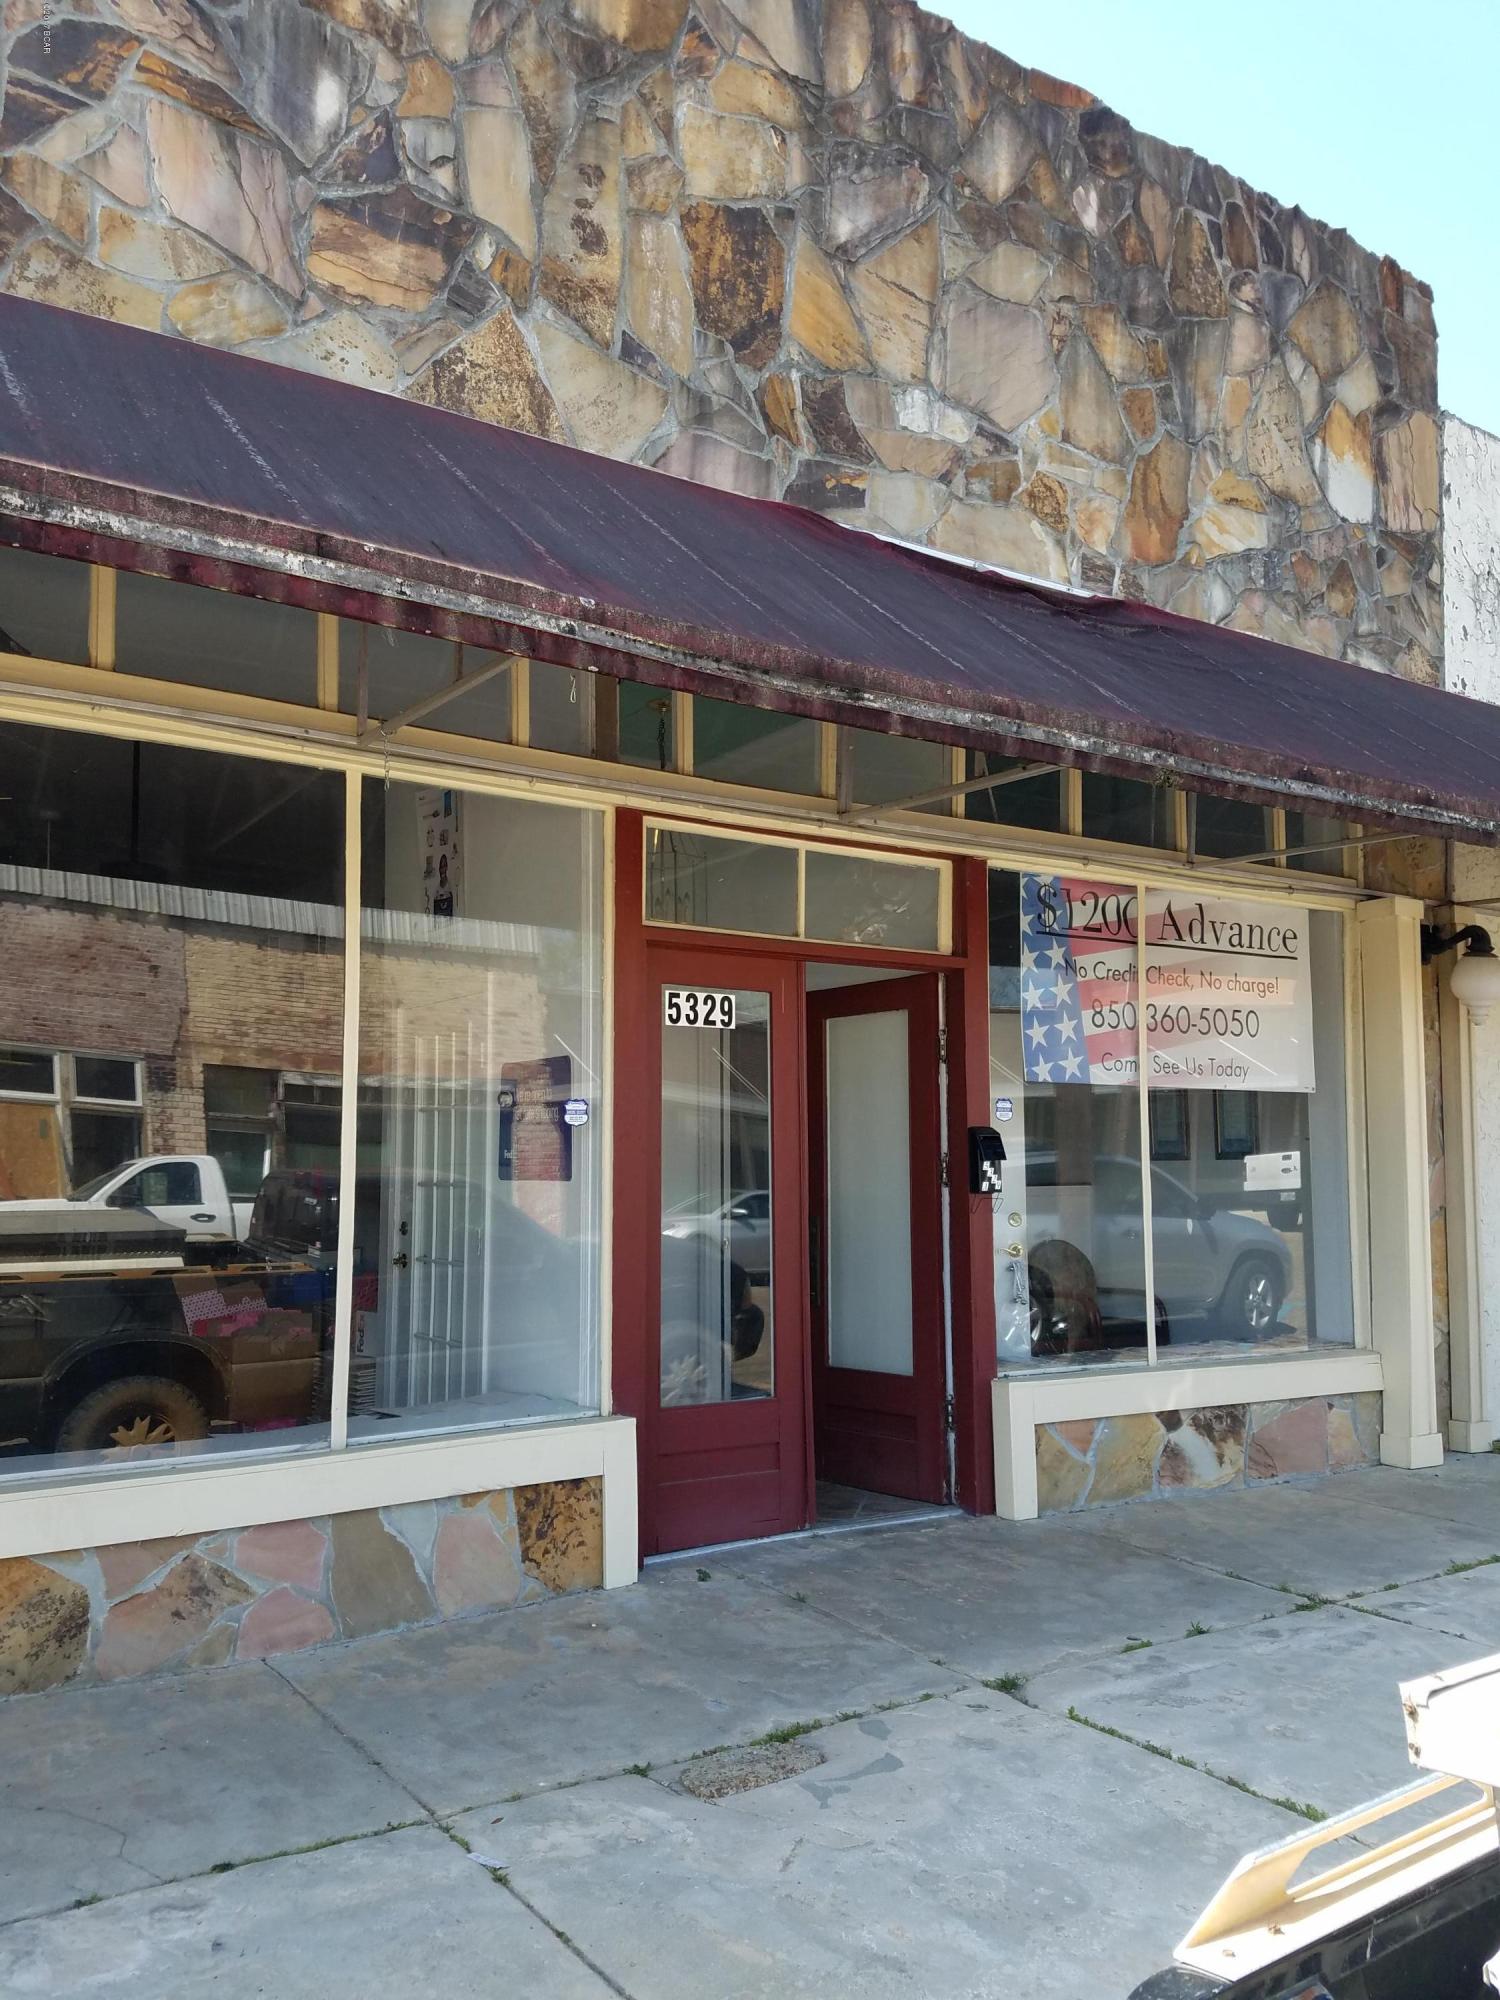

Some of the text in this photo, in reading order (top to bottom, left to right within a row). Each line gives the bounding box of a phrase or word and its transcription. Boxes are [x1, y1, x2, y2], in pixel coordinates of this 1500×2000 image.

[1157, 900, 1298, 953] Advance
[1065, 958, 1280, 998] No Credi Check, No charge!
[667, 992, 733, 1028] 5329
[1101, 1053, 1250, 1083] Com See Us Today
